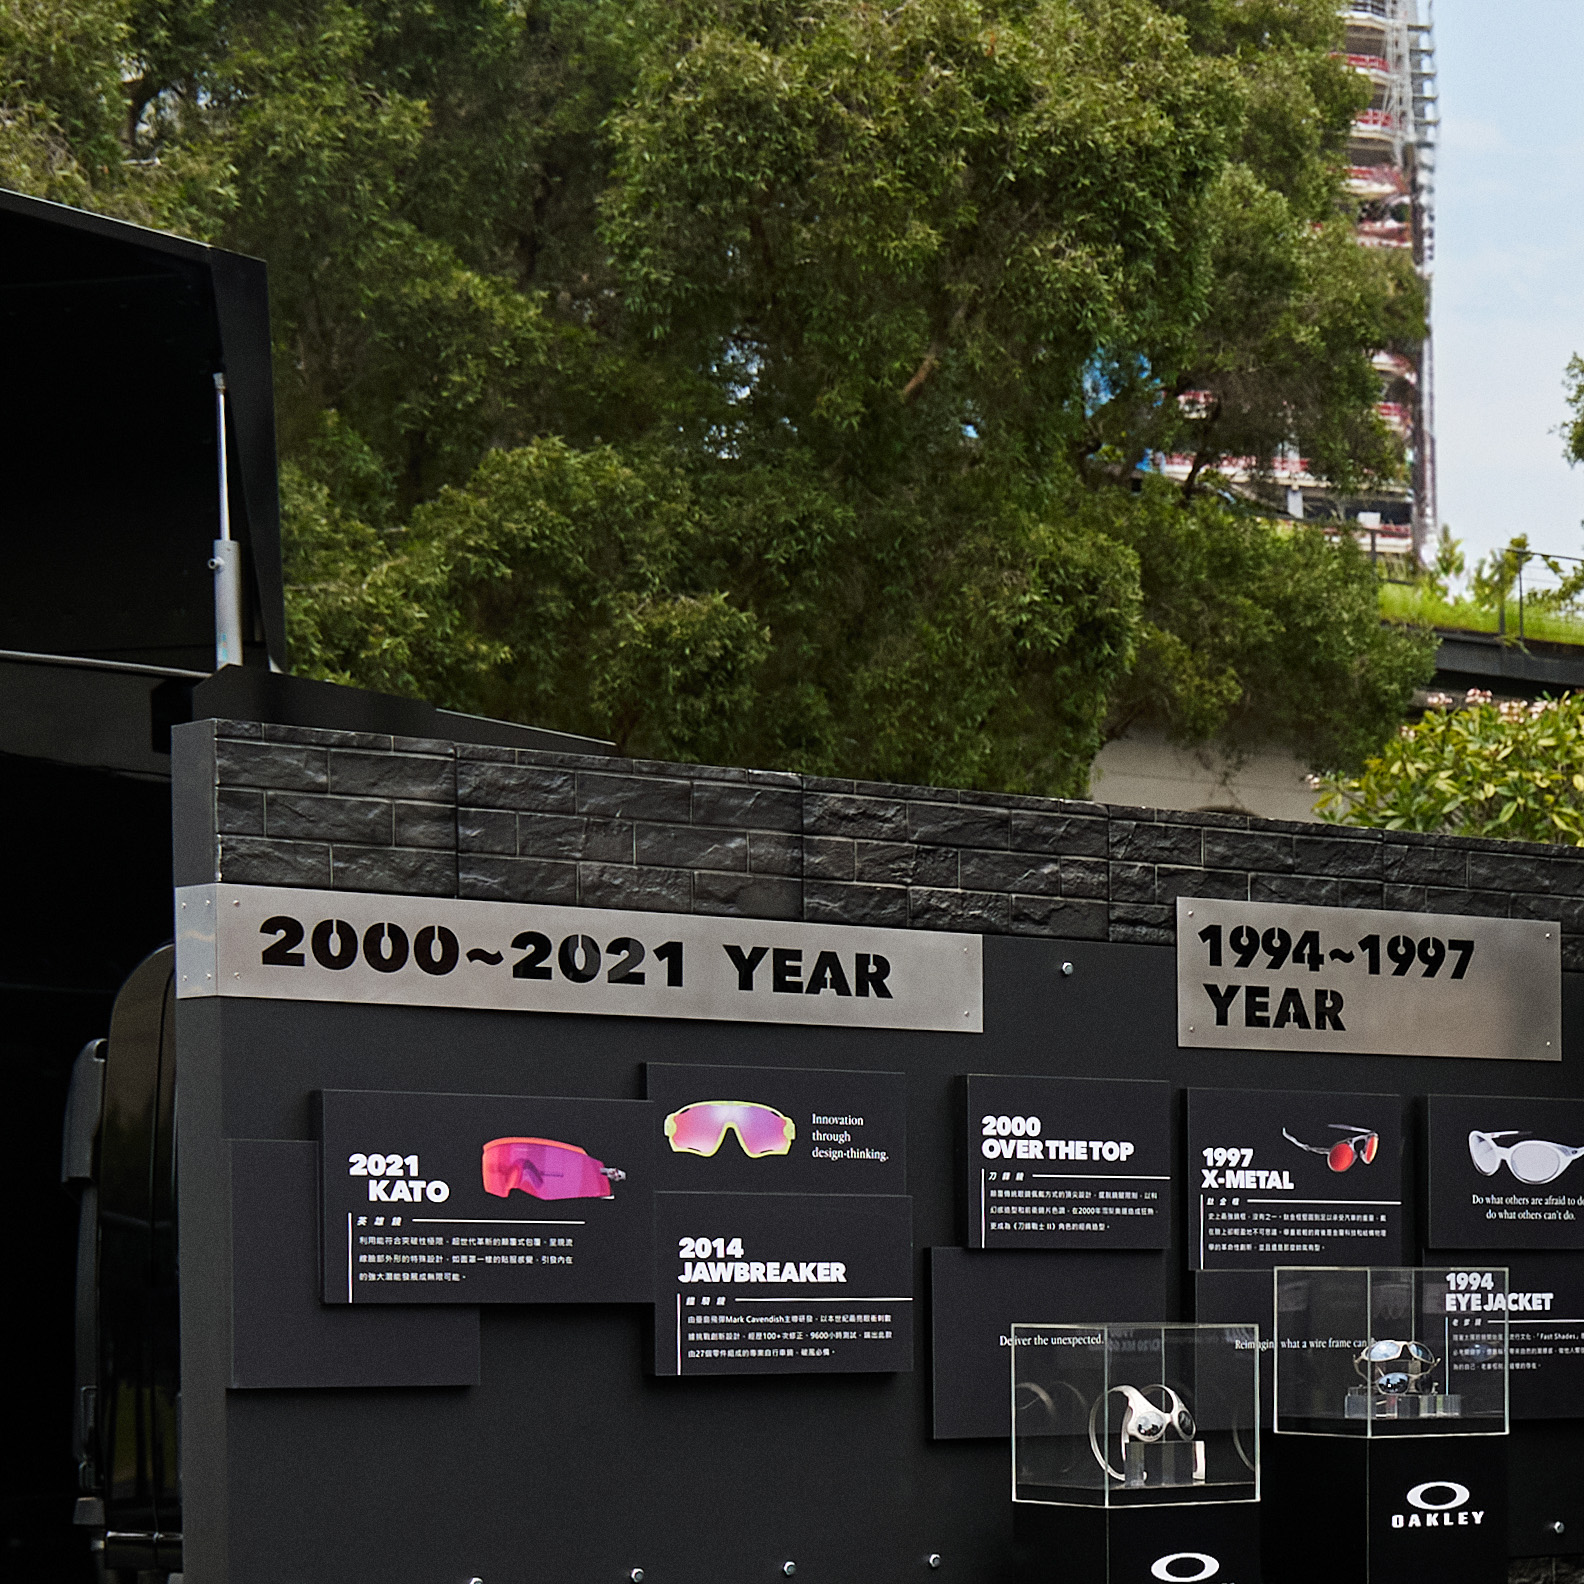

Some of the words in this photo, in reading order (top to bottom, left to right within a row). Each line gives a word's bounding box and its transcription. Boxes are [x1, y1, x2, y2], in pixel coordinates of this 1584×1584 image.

[259, 915, 685, 987] 2000~2021
[724, 944, 894, 999] YEAR
[1198, 923, 1475, 980] 1994~1997
[1202, 983, 1347, 1032] YEAR
[812, 1113, 864, 1127] Innovation
[981, 1115, 1042, 1137] 2000
[812, 1130, 852, 1144] through
[811, 1146, 890, 1162] design-thinking.
[981, 1138, 1044, 1159] OVER
[1045, 1139, 1088, 1161] THE
[1088, 1140, 1135, 1162] TOP
[1202, 1147, 1254, 1168] 1997
[348, 1154, 420, 1177] 2021
[1201, 1168, 1295, 1190] X-METAL
[368, 1180, 451, 1203] KATO
[1472, 1194, 1484, 1205] Do
[1485, 1194, 1504, 1205] what
[1505, 1194, 1530, 1206] others
[1531, 1197, 1543, 1206] are
[1544, 1195, 1566, 1206] afraid
[1567, 1197, 1576, 1206] to
[1486, 1208, 1497, 1219] do
[1498, 1209, 1517, 1219] what
[1518, 1209, 1542, 1220] others
[1543, 1210, 1562, 1220] can't
[678, 1237, 745, 1259] 2014
[677, 1261, 847, 1283] JAWBREAKER
[1445, 1272, 1495, 1291] 1994
[1445, 1293, 1482, 1312] EYE
[1483, 1292, 1554, 1312] JACKET
[999, 1335, 1033, 1347] Deiver
[1033, 1334, 1049, 1346] the
[1050, 1333, 1105, 1347] unexpected.
[1280, 1338, 1301, 1349] what
[1301, 1340, 1307, 1348] a
[1308, 1338, 1327, 1348] wire
[1328, 1337, 1352, 1348] frame
[1353, 1340, 1367, 1348] can
[1391, 1511, 1485, 1529] OAKLEY
